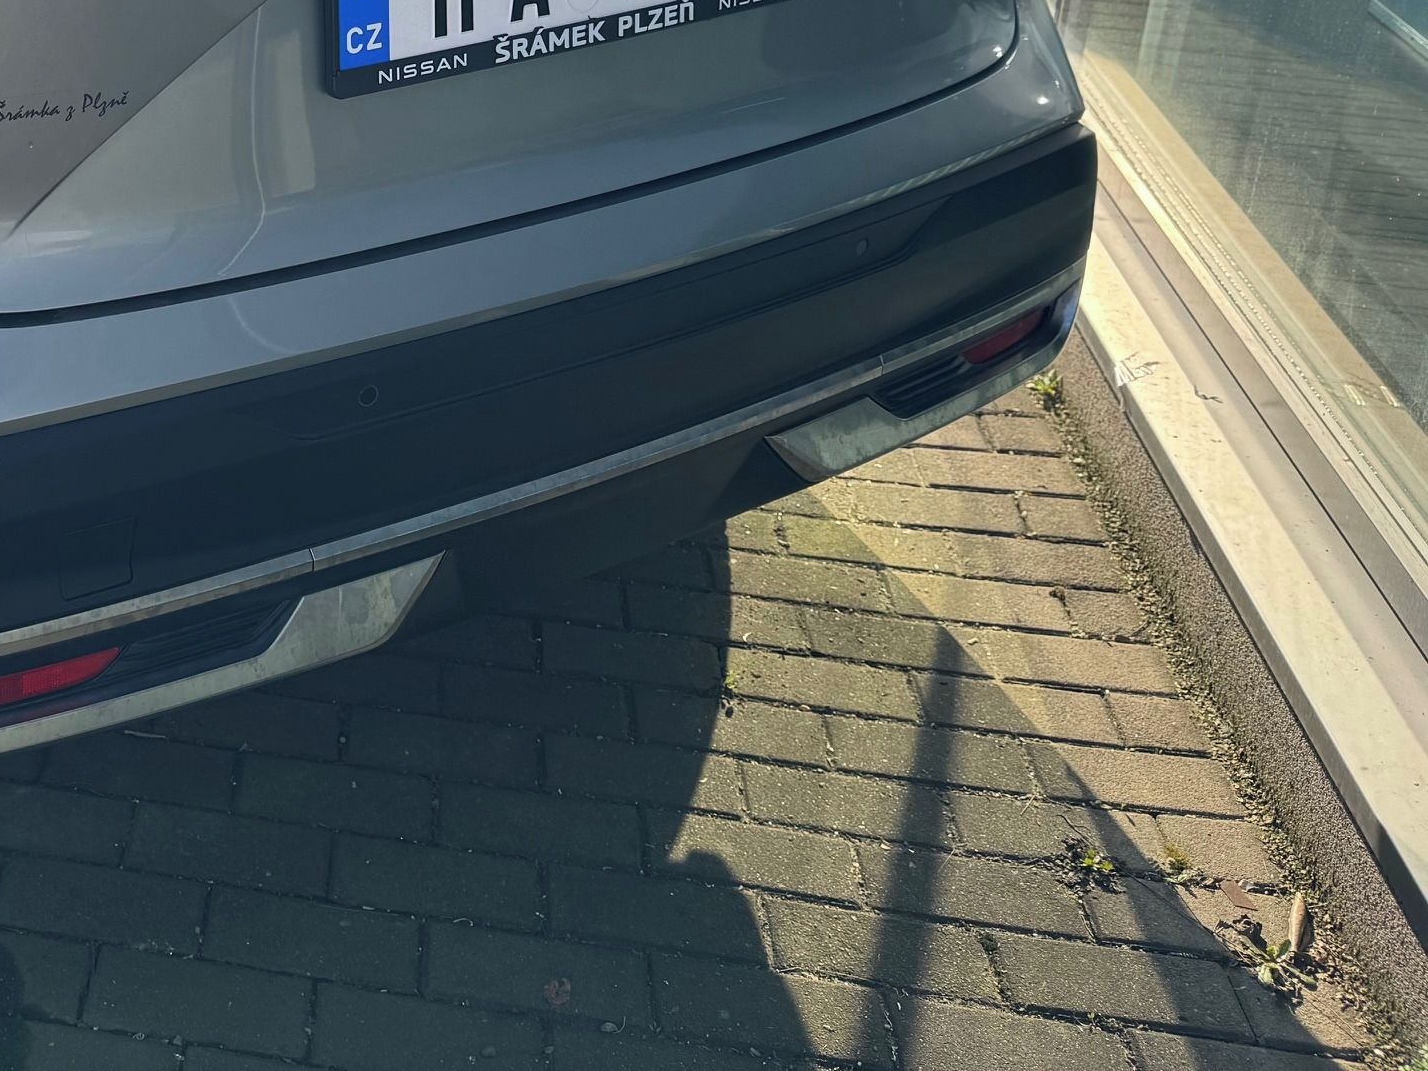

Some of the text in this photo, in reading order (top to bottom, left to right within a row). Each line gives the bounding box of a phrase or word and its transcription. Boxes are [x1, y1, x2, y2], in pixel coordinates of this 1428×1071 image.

[346, 23, 383, 55] CZ
[494, 20, 606, 64] ŠRÁMEK
[378, 52, 468, 85] NISSAN
[65, 104, 76, 122] z
[82, 90, 130, 115] Plzně
